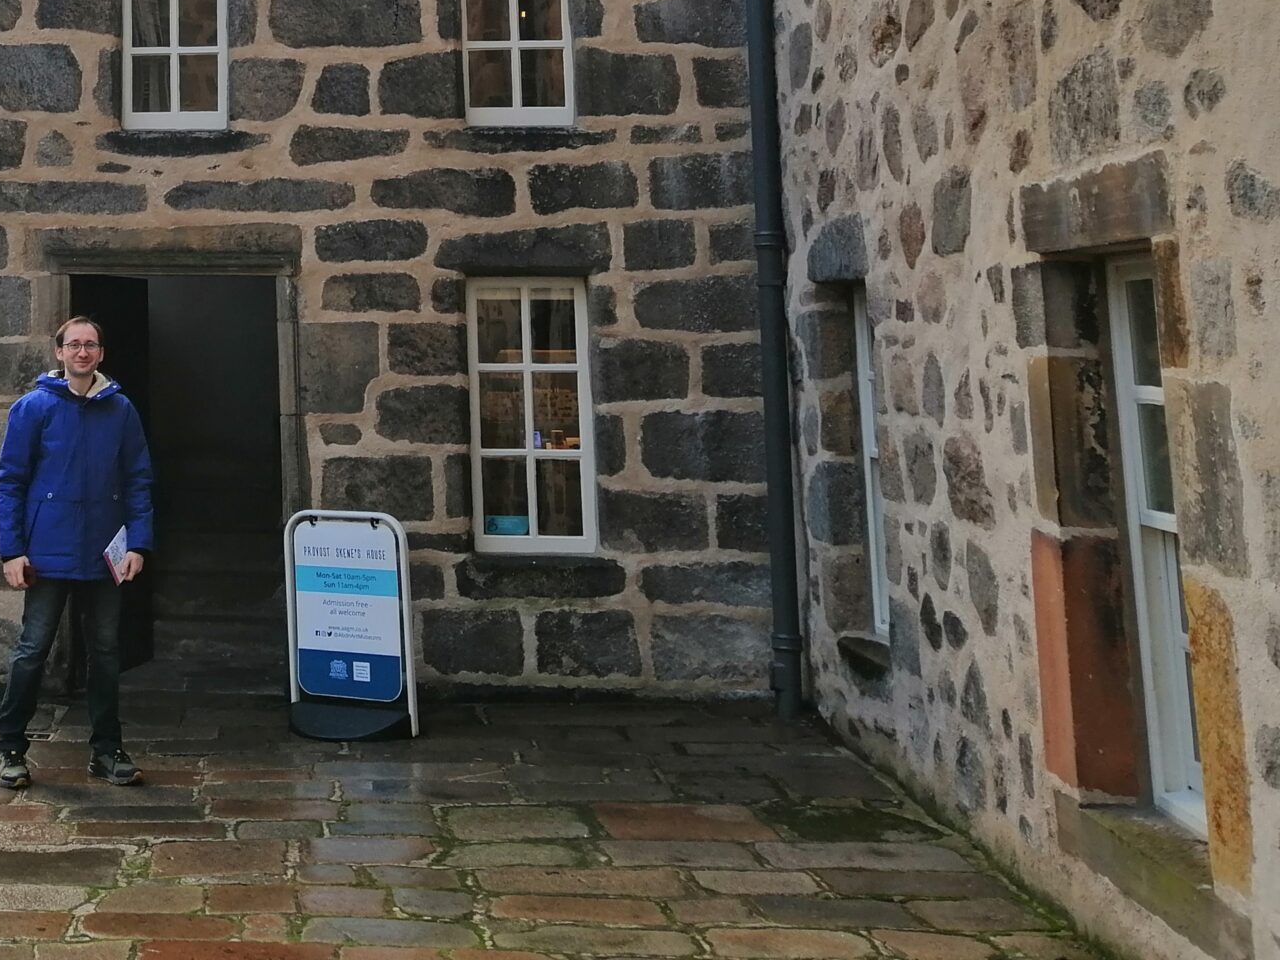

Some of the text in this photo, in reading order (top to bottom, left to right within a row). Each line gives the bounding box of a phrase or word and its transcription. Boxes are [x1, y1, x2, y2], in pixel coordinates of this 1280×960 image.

[303, 546, 386, 560] PROVOST SKENE'S HOUSE
[316, 571, 377, 583] Mon-Sat 10am-5pm
[323, 581, 370, 592] Sun 11am-4pm
[322, 599, 355, 608] Admission
[355, 600, 369, 609] free
[338, 609, 366, 617] welcome
